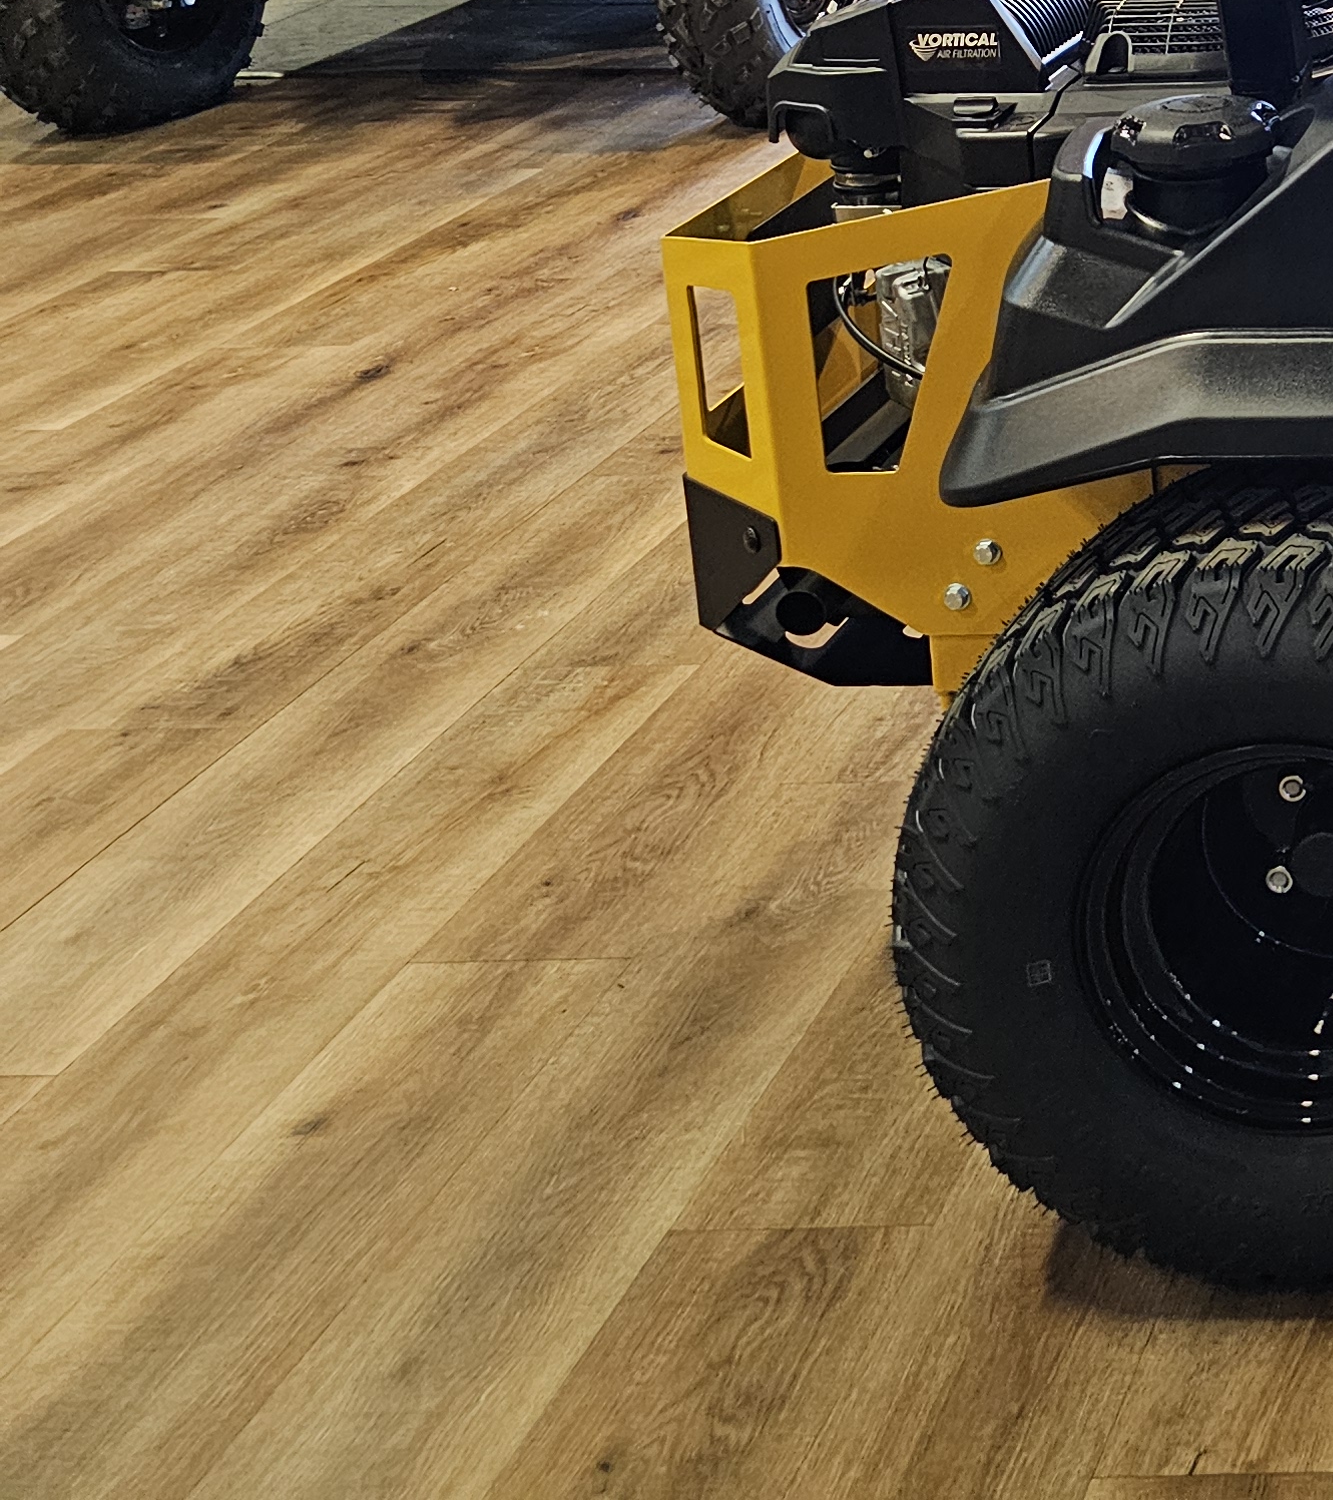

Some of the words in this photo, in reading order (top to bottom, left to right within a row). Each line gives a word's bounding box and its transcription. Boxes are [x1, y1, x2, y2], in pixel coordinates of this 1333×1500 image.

[917, 32, 998, 47] VORTICAL
[937, 49, 951, 58] AIR
[953, 49, 997, 58] FILTRATION
